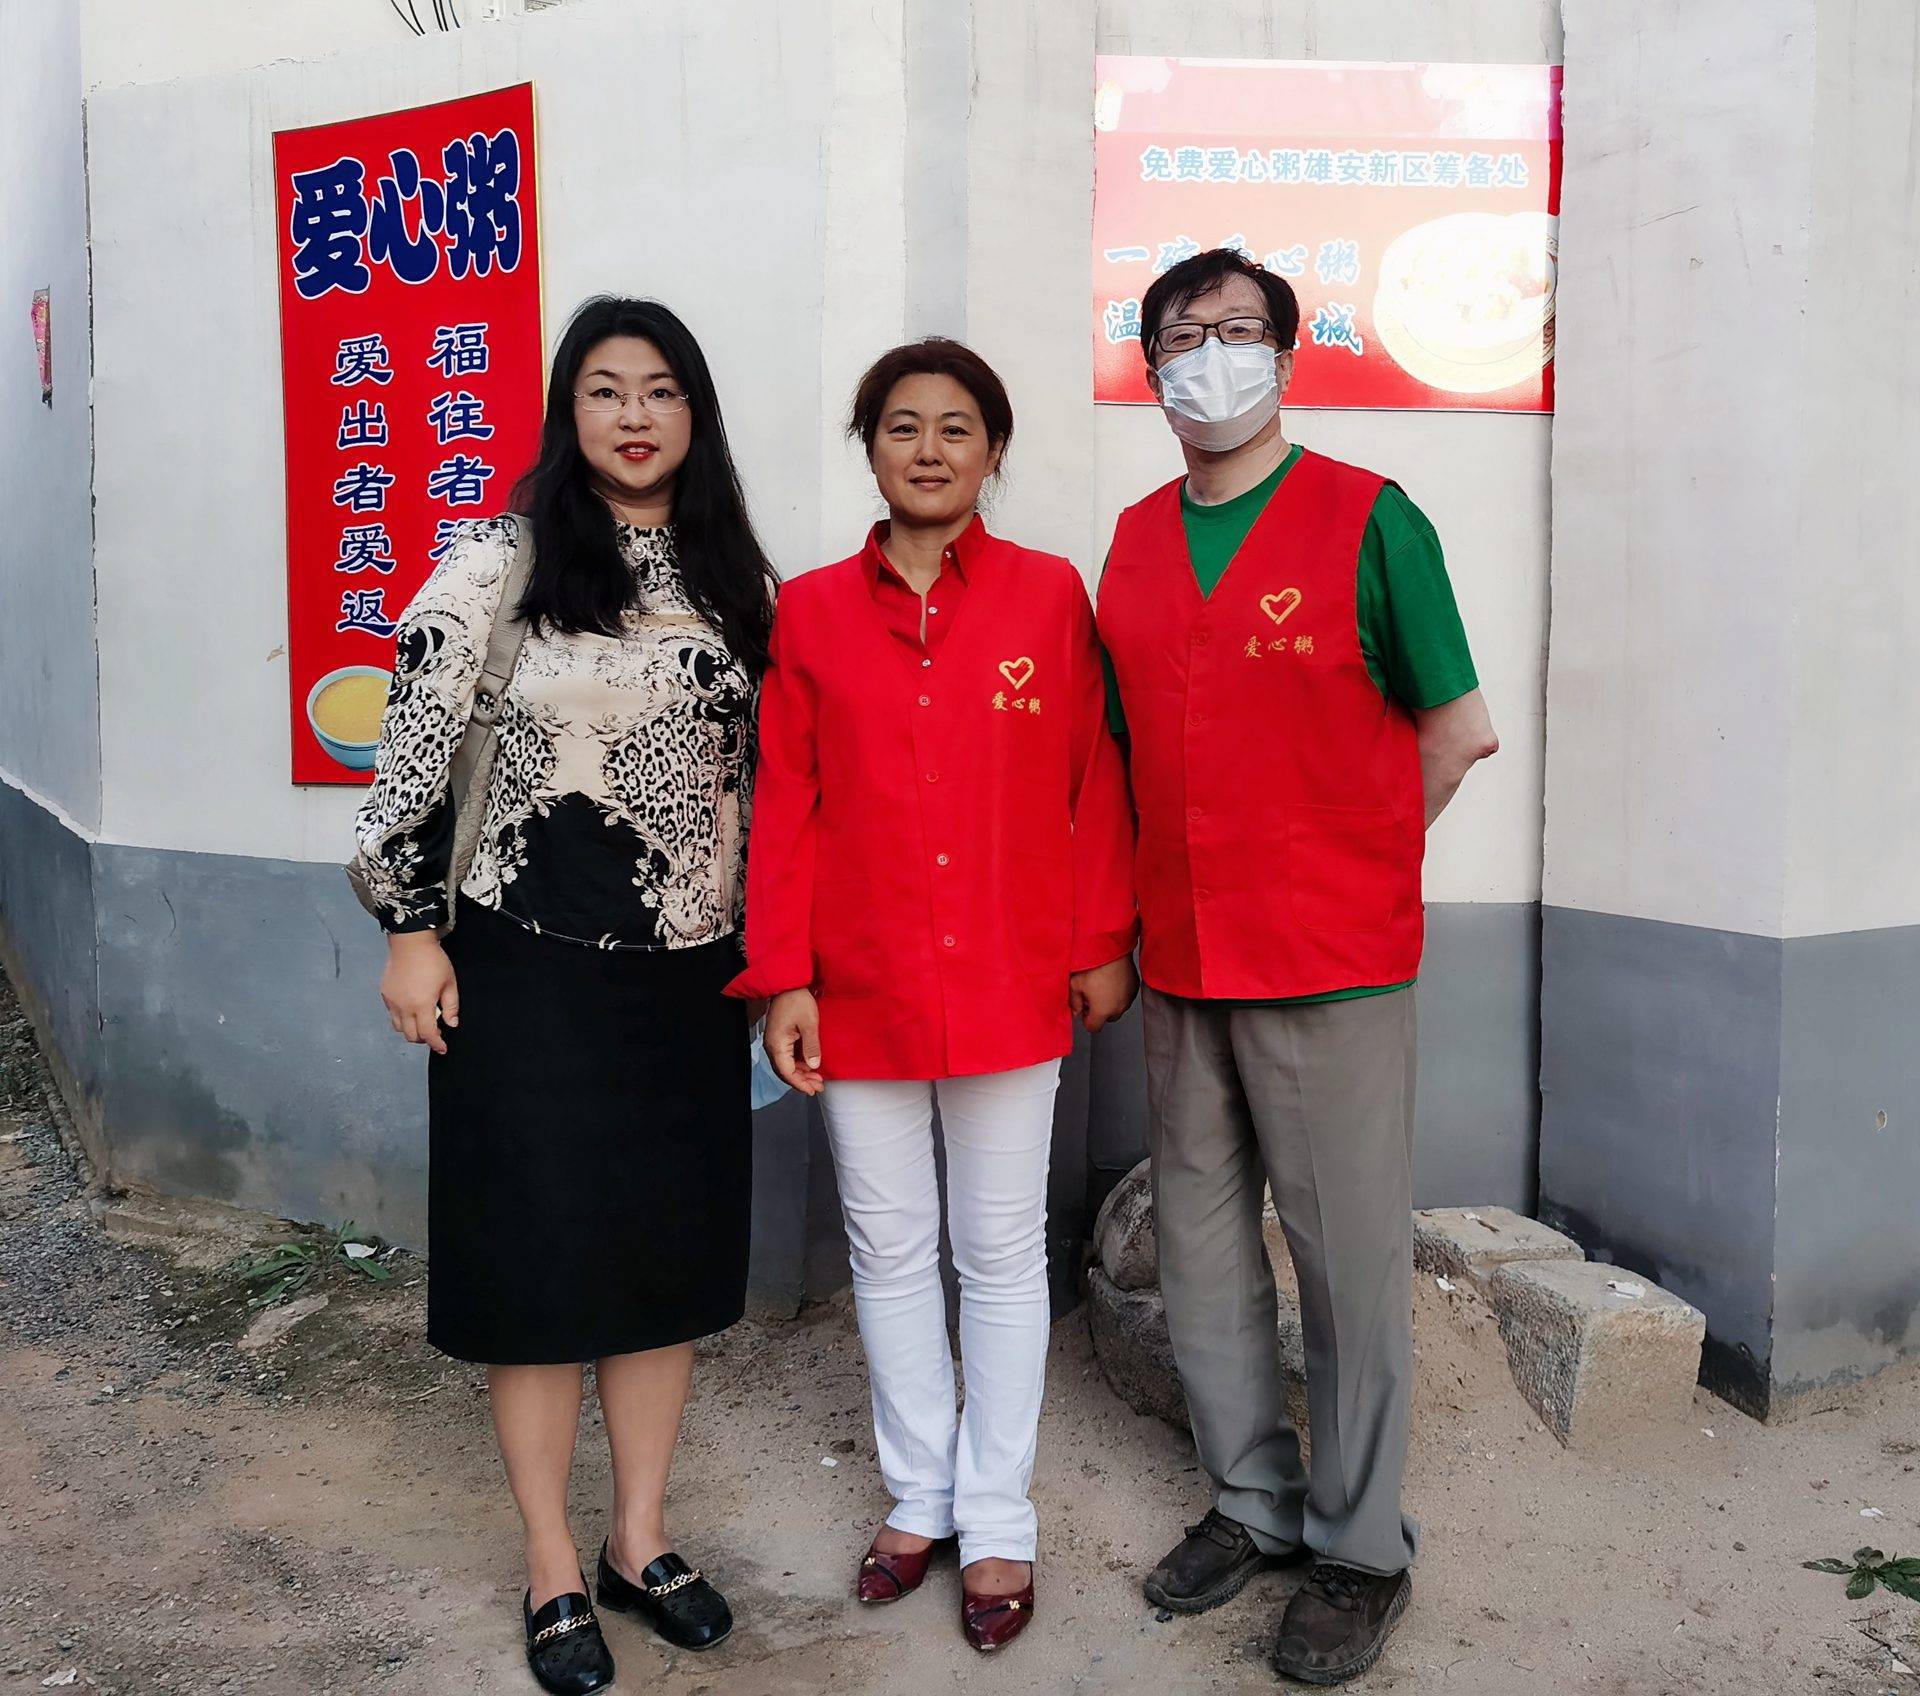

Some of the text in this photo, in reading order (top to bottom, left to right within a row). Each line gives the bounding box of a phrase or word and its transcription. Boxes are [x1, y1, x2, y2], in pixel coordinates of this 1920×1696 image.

[1141, 145, 1530, 187] 免费爱心粥雄安新区筹备处
[291, 128, 522, 300] 爱心粥
[331, 333, 399, 639] 爱出者爱返
[1243, 635, 1314, 658] 爱心粥
[991, 690, 1041, 715] 爱心粥
